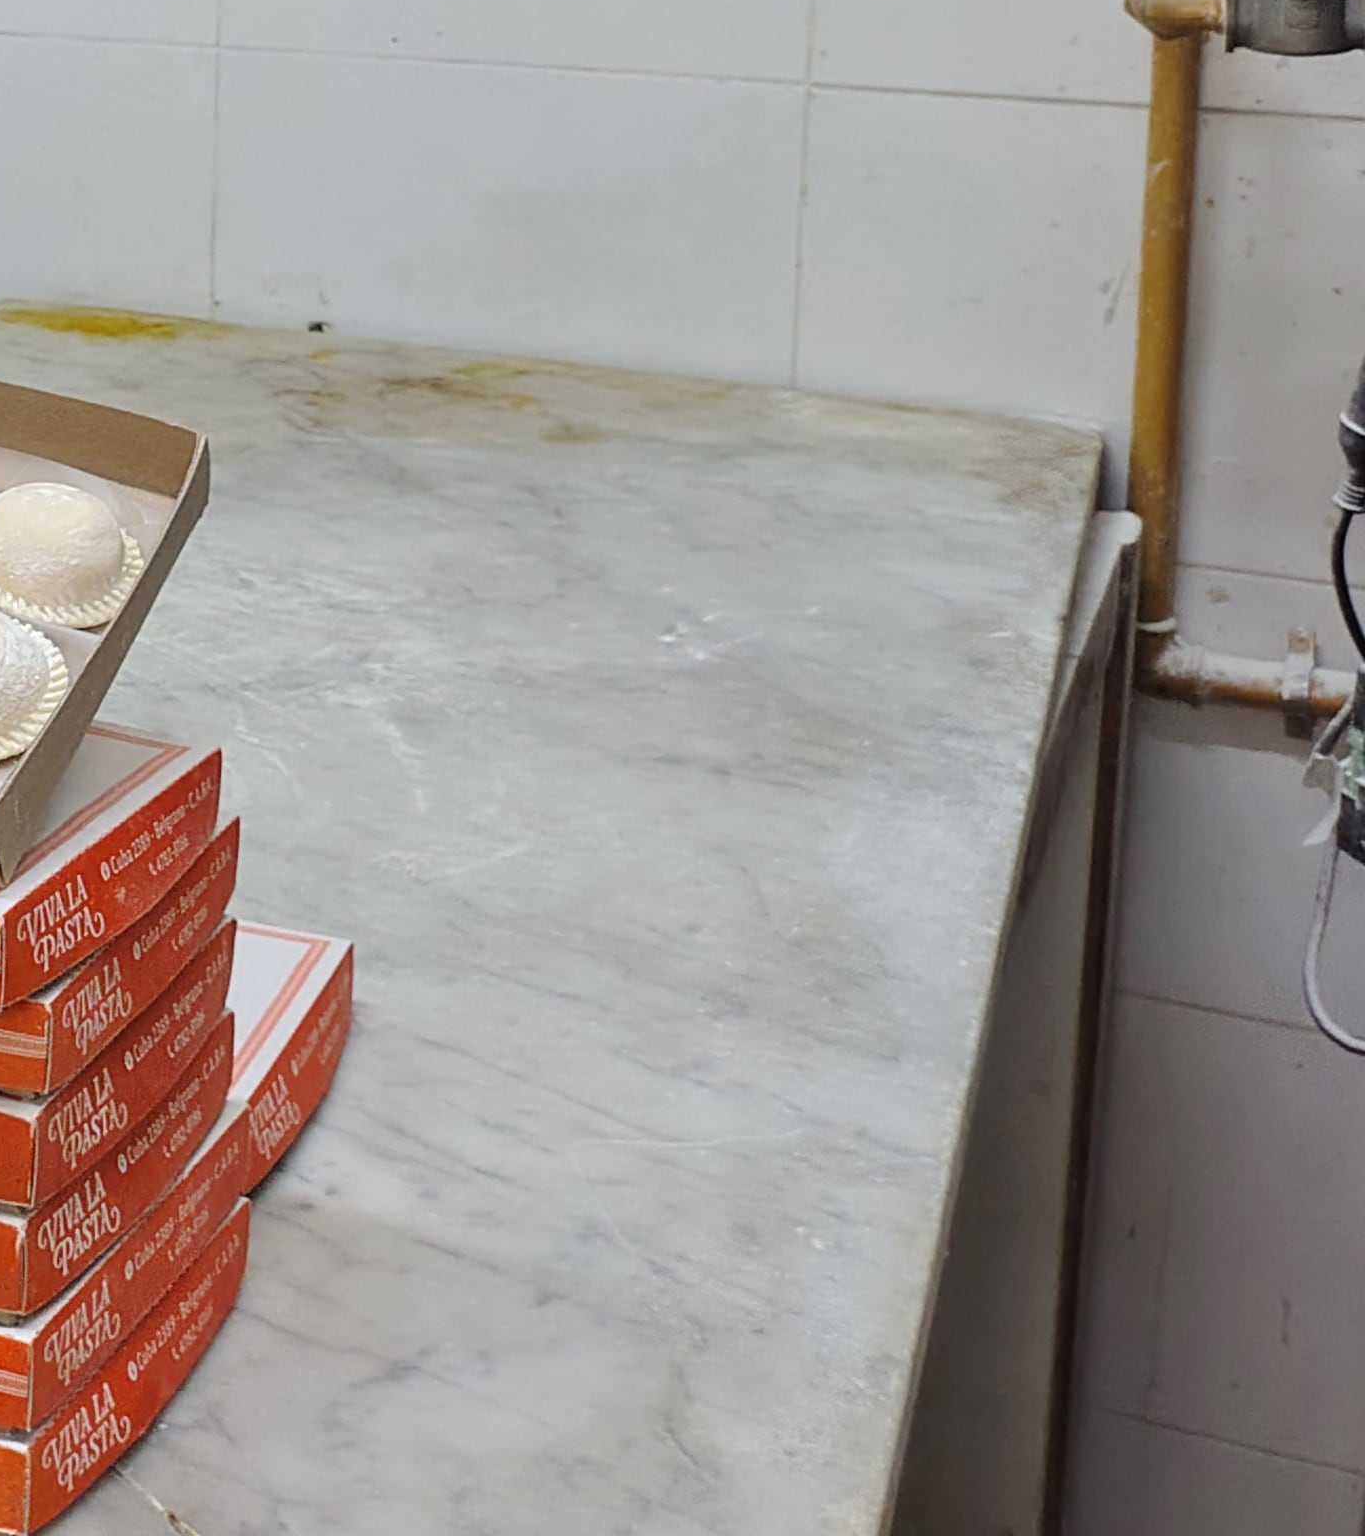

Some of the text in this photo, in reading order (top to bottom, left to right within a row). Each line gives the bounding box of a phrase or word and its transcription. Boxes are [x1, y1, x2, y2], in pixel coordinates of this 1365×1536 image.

[110, 843, 133, 875] Cuba
[131, 831, 152, 859] 2389
[152, 805, 186, 840] Belgrano
[17, 875, 89, 948] VIVA LA
[34, 906, 105, 972] PASTA
[62, 957, 122, 1031] VIVA LA
[75, 987, 133, 1056] PASTA
[132, 1033, 153, 1063] Cuba
[48, 1067, 115, 1145] VIVA LA
[272, 1074, 289, 1106] LA
[62, 1099, 129, 1170] PASTA
[126, 1135, 149, 1164] Cuba
[254, 1100, 301, 1160] PASTA
[38, 1171, 107, 1252] VIVA LA
[53, 1202, 120, 1276] PASTA
[43, 1277, 113, 1365] VIVA LA
[57, 1313, 121, 1386] PASTA
[42, 1381, 116, 1470] VIVA LA
[58, 1413, 131, 1491] PASTA
